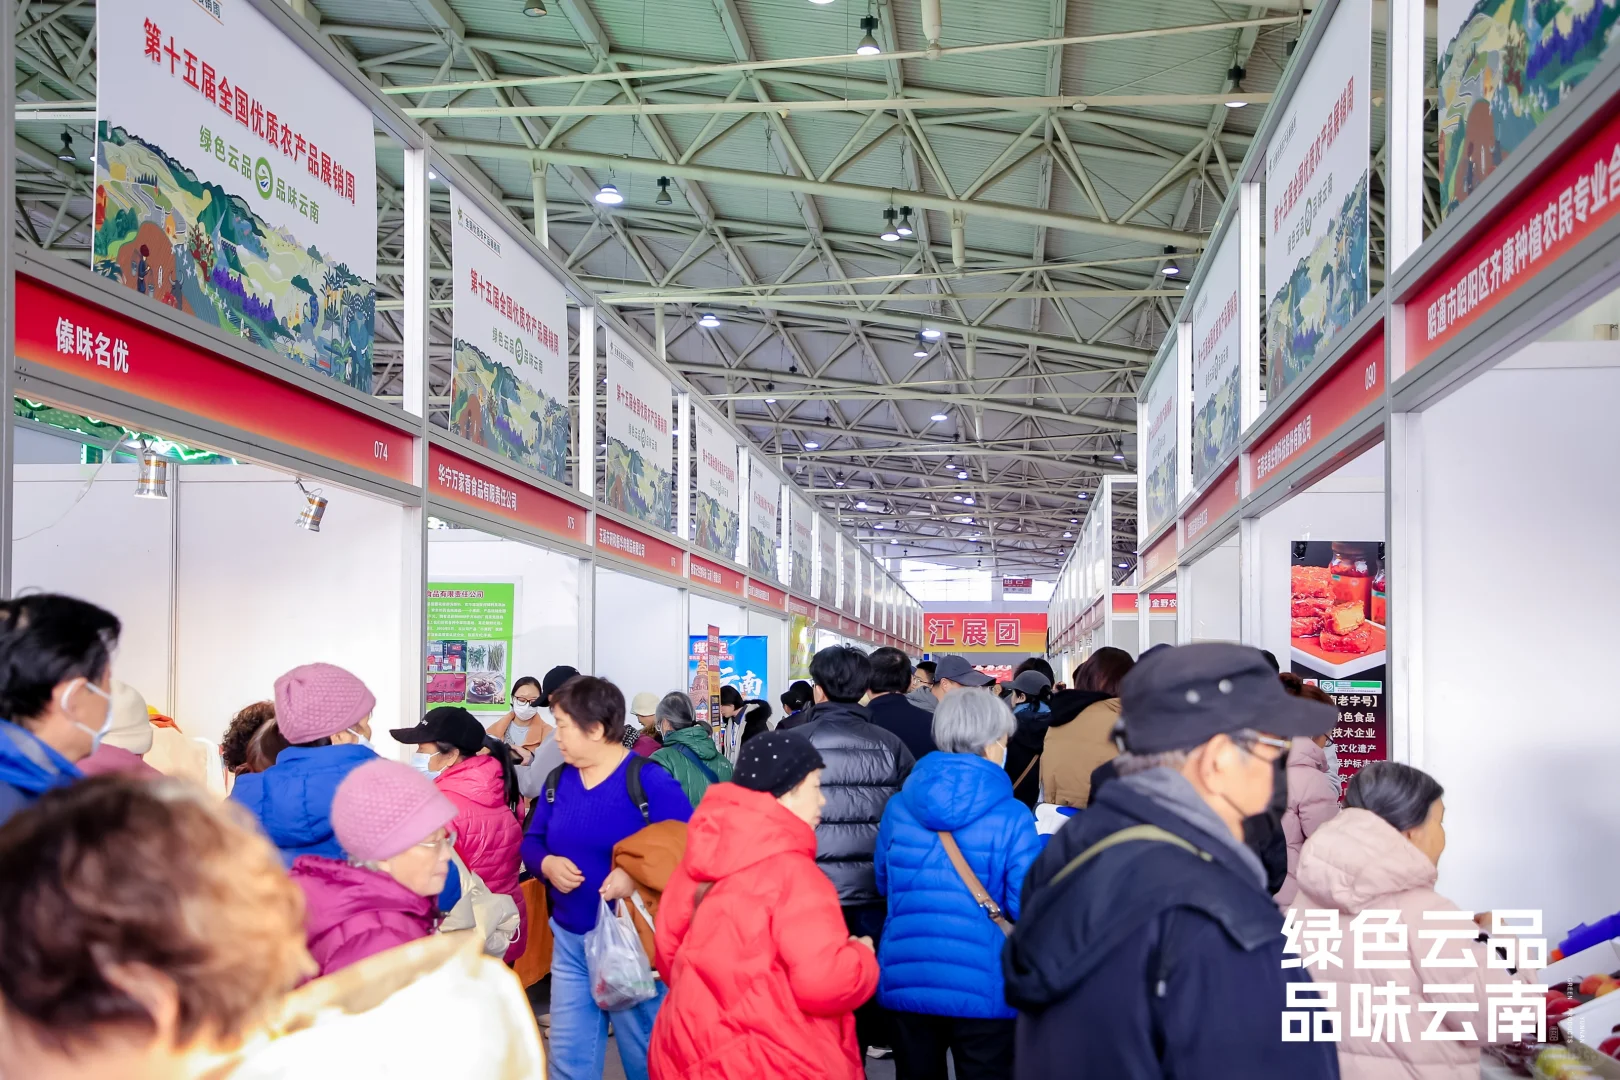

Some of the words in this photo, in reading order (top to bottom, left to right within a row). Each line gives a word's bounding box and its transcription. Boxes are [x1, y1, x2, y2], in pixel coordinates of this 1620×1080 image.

[143, 17, 356, 205] 第十五届全国优质农产品展销周
[199, 124, 252, 179] 绿色云品
[275, 177, 320, 225] 品味云南
[470, 267, 559, 357] 第十五届全国优质农产品展销周
[55, 316, 130, 374] 傣味名优
[1364, 361, 1376, 391] 090
[373, 439, 388, 462] 074
[438, 463, 517, 511] 华宁万家香食品有限责任公司
[928, 617, 1021, 646] 江展团
